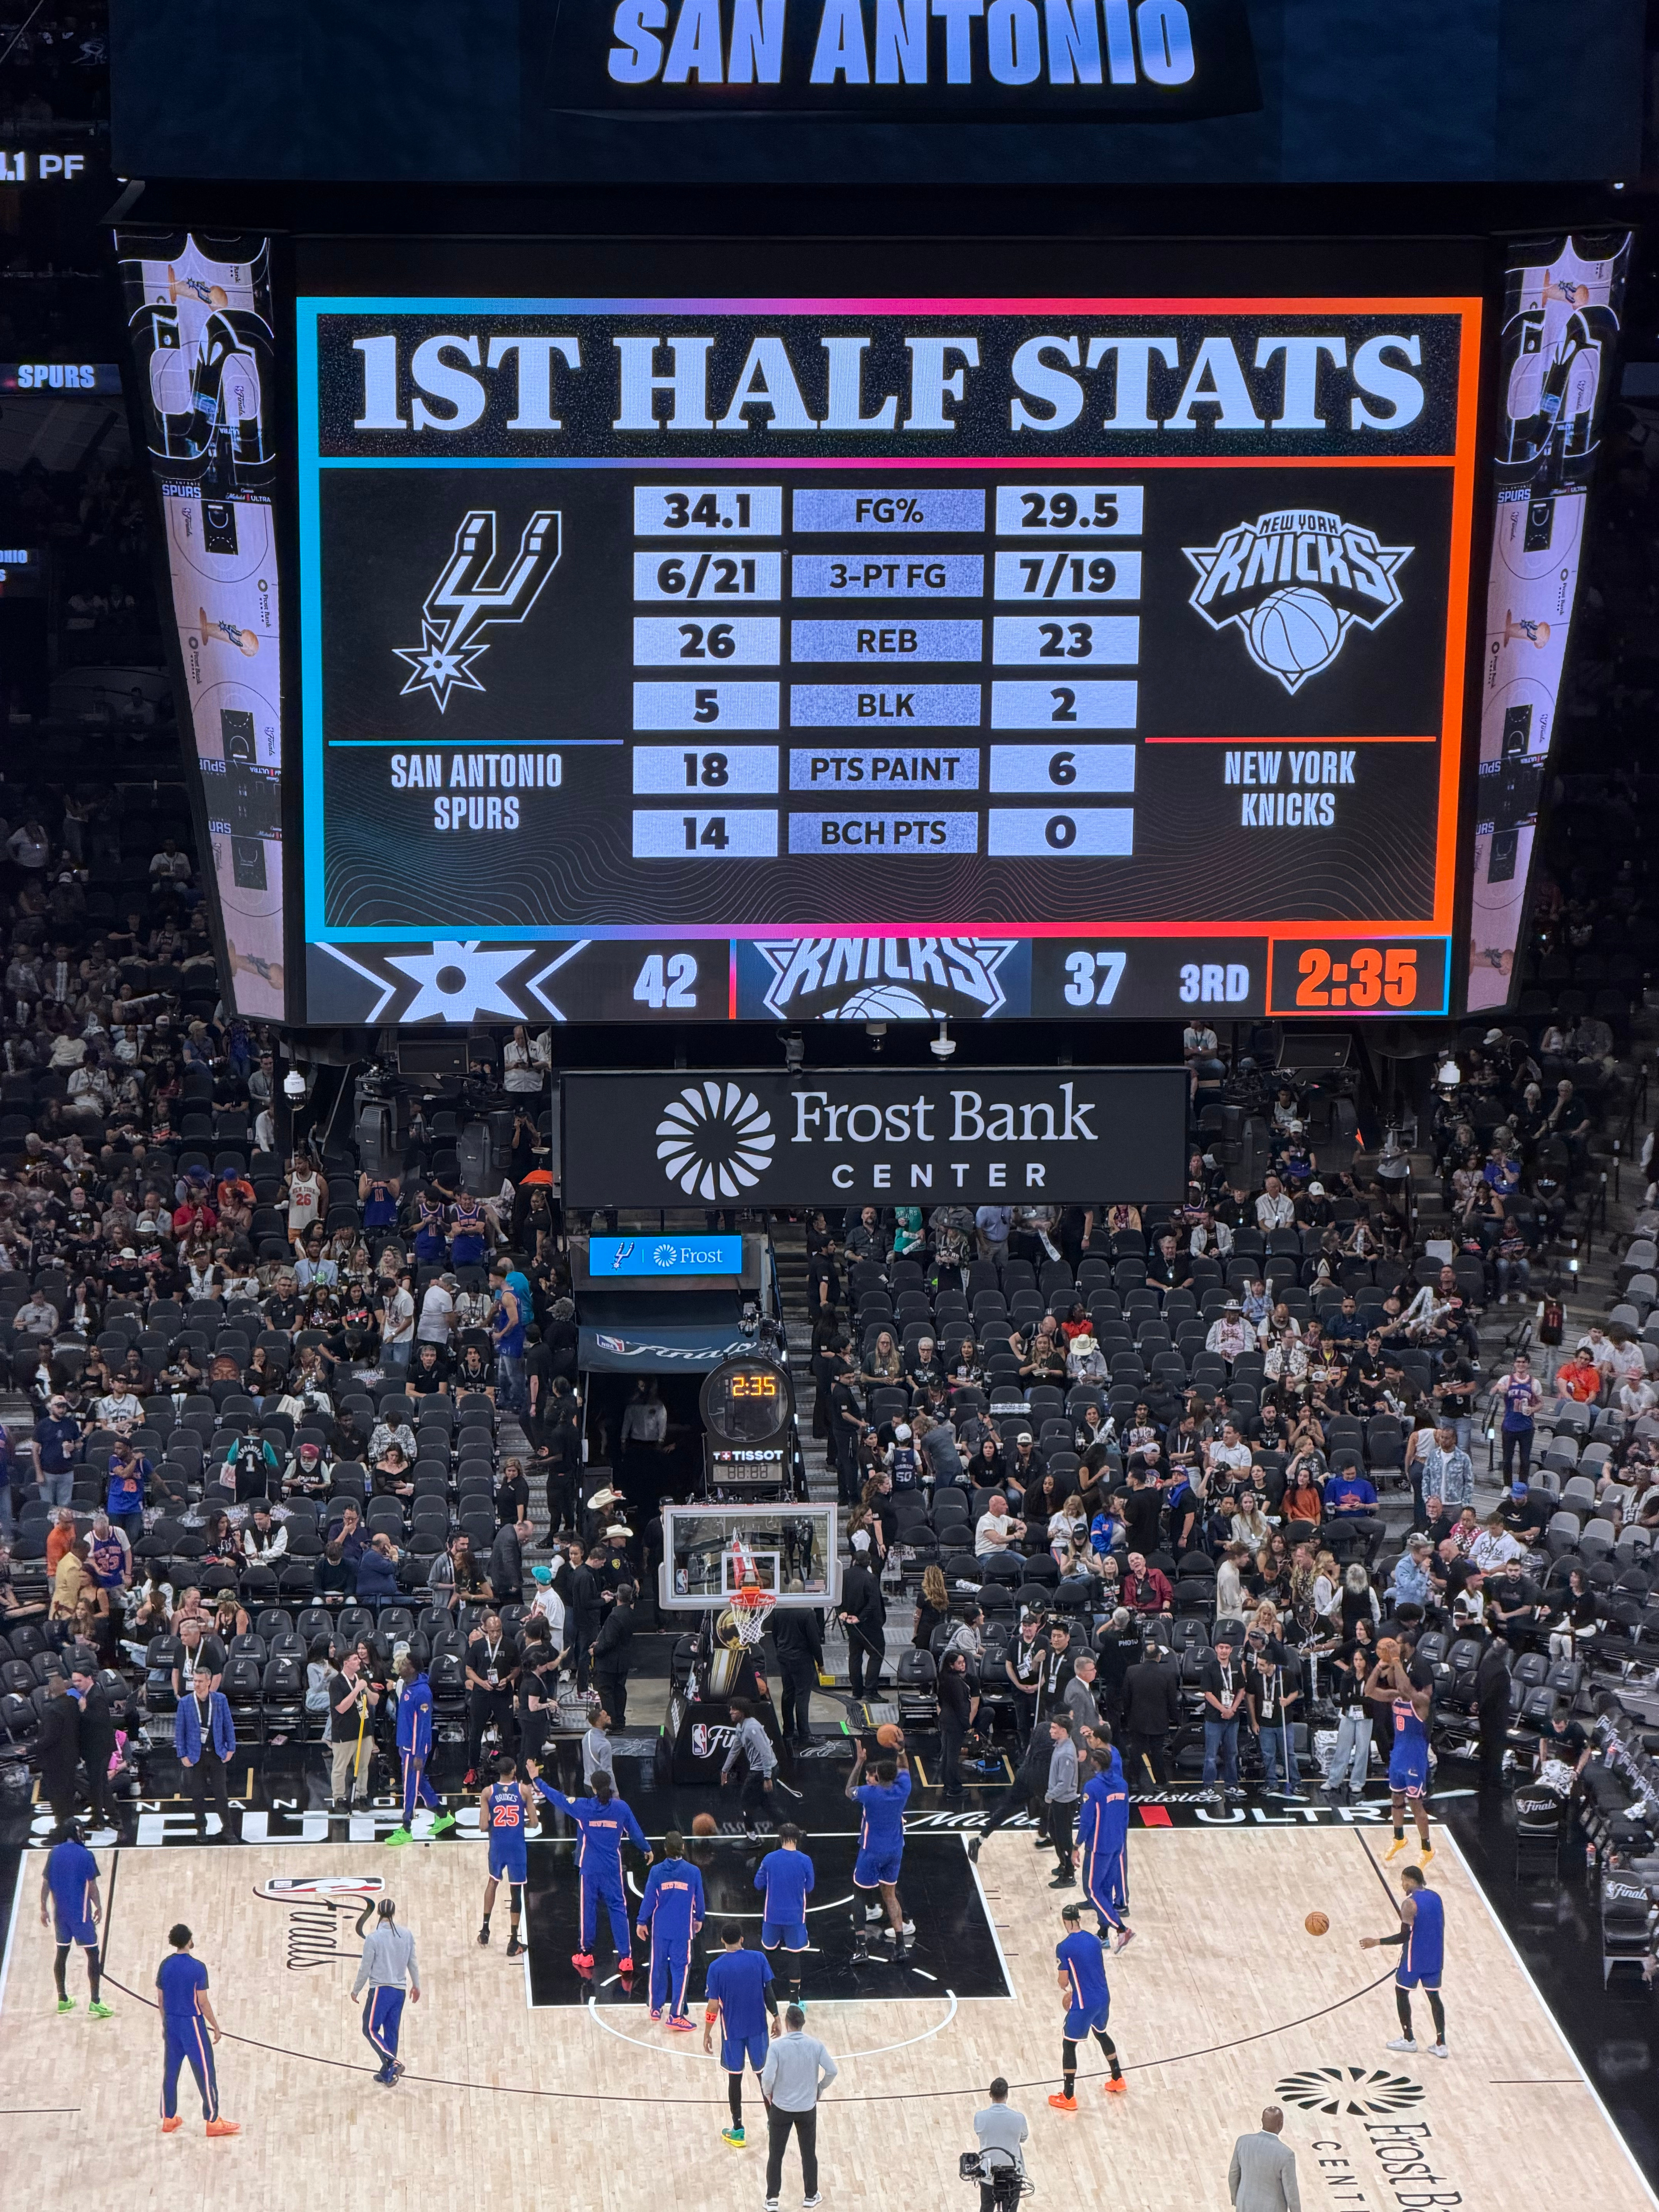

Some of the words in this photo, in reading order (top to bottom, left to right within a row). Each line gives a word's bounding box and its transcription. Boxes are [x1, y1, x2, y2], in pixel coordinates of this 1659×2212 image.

[608, 0, 781, 84] SAN
[810, 0, 1195, 85] ANTONIO
[40, 155, 84, 179] PF
[18, 365, 95, 388] SPURS
[352, 335, 581, 431] 1ST
[613, 336, 980, 430] HALF
[1011, 335, 1424, 431] STATS
[162, 484, 201, 498] SPURS
[1498, 488, 1531, 503] SPURS
[663, 493, 750, 528] 34.1
[856, 498, 924, 523] FG%
[1020, 493, 1118, 528] 29.5
[1259, 514, 1293, 535] NEW
[1298, 514, 1339, 535] YORK
[657, 554, 755, 598] 6/21
[830, 564, 900, 588] 3-PT
[907, 564, 946, 588] FG
[1020, 554, 1116, 598] 7/19
[1199, 532, 1396, 606] KNICKS
[678, 623, 735, 658] 26
[857, 629, 918, 653] REB
[1038, 623, 1092, 658] 23
[693, 689, 719, 723] 5
[857, 693, 915, 717] BLK
[1050, 687, 1077, 721] 2
[391, 754, 441, 788] SAN
[450, 754, 562, 788] ANTONIO
[684, 752, 729, 787] 18
[811, 757, 864, 781] PTS
[872, 757, 960, 781] PAINT
[1048, 751, 1077, 786] 6
[1224, 751, 1282, 784] NEW
[1288, 750, 1356, 784] YORK
[434, 796, 519, 830] SPURS
[1242, 792, 1335, 826] KNICKS
[684, 817, 729, 850] 14
[821, 821, 885, 845] BCH
[893, 820, 946, 845] PTS
[1045, 815, 1077, 849] 0
[633, 953, 697, 1008] 42
[1064, 951, 1127, 1006] 37
[1180, 964, 1249, 1003] 3RD
[1296, 948, 1417, 1007] 2:35
[791, 1092, 935, 1142] Frost
[949, 1082, 1099, 1141] Bank
[832, 1163, 1046, 1188] CENTER
[296, 1194, 311, 1206] 26
[680, 1248, 723, 1263] Frost
[601, 1341, 614, 1350] NBA
[611, 1341, 757, 1360] Finals
[732, 1376, 775, 1396] 2:35
[246, 1454, 255, 1472] 1
[732, 1450, 783, 1461] TISSOT
[896, 1472, 912, 1482] 50
[34, 1802, 161, 1814] SN
[495, 1793, 518, 1803] BRIDGES
[1524, 1799, 1558, 1814] Finals
[493, 1805, 519, 1827] 25
[1609, 1883, 1649, 1900] Finals
[253, 1887, 375, 1970] Finals
[1364, 2123, 1447, 2185] Frost
